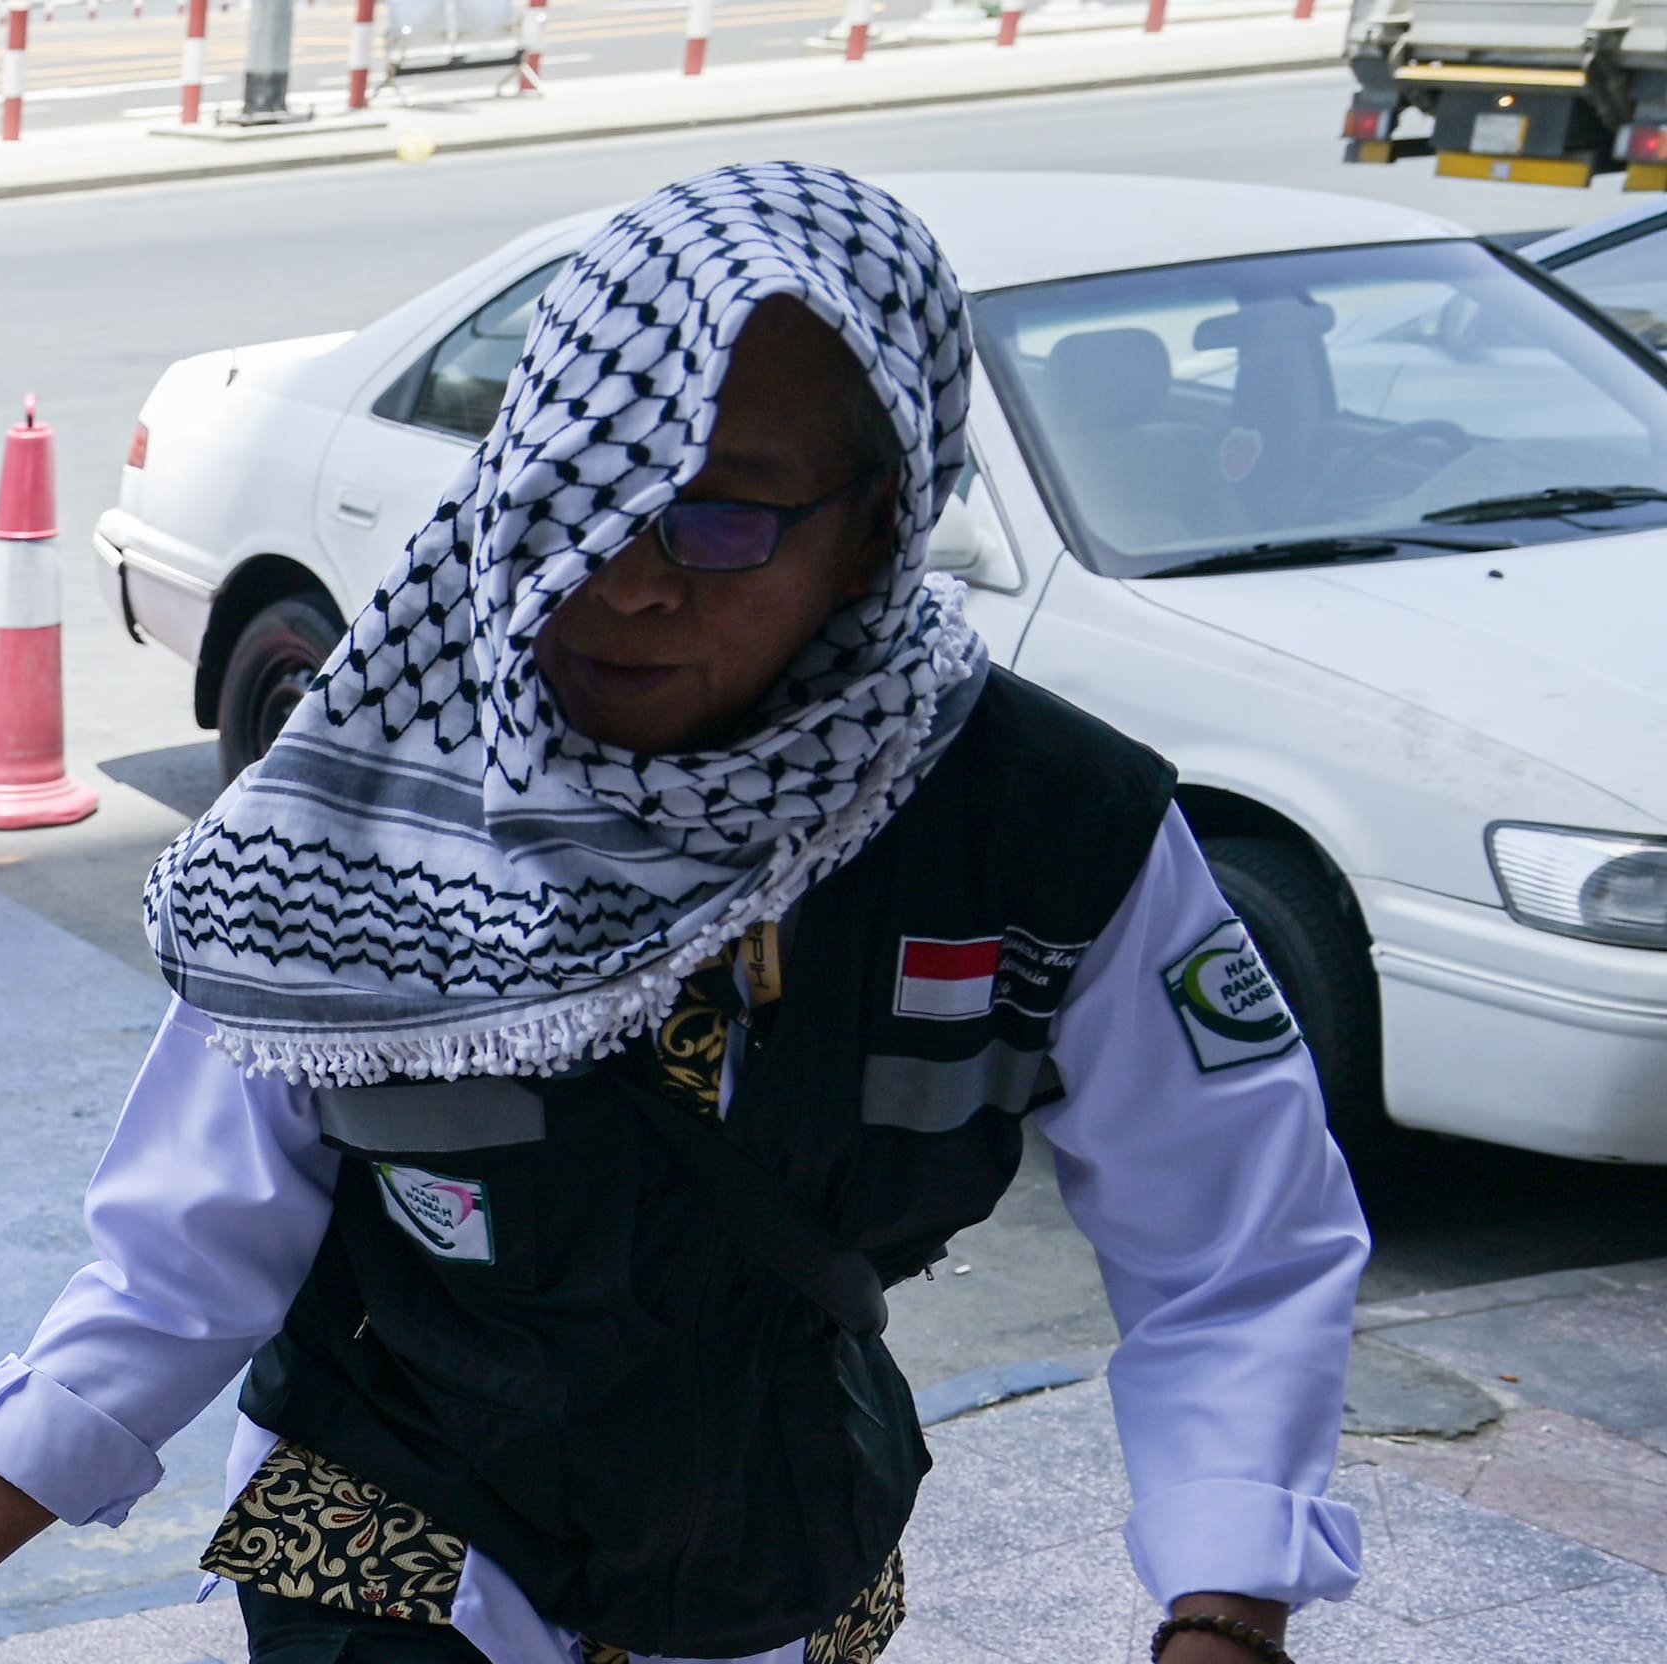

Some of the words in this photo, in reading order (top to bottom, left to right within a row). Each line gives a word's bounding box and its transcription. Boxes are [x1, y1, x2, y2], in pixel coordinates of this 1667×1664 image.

[1225, 952, 1258, 979] HAJ
[1220, 970, 1268, 1000] RAMA
[1228, 984, 1276, 1016] LANSI
